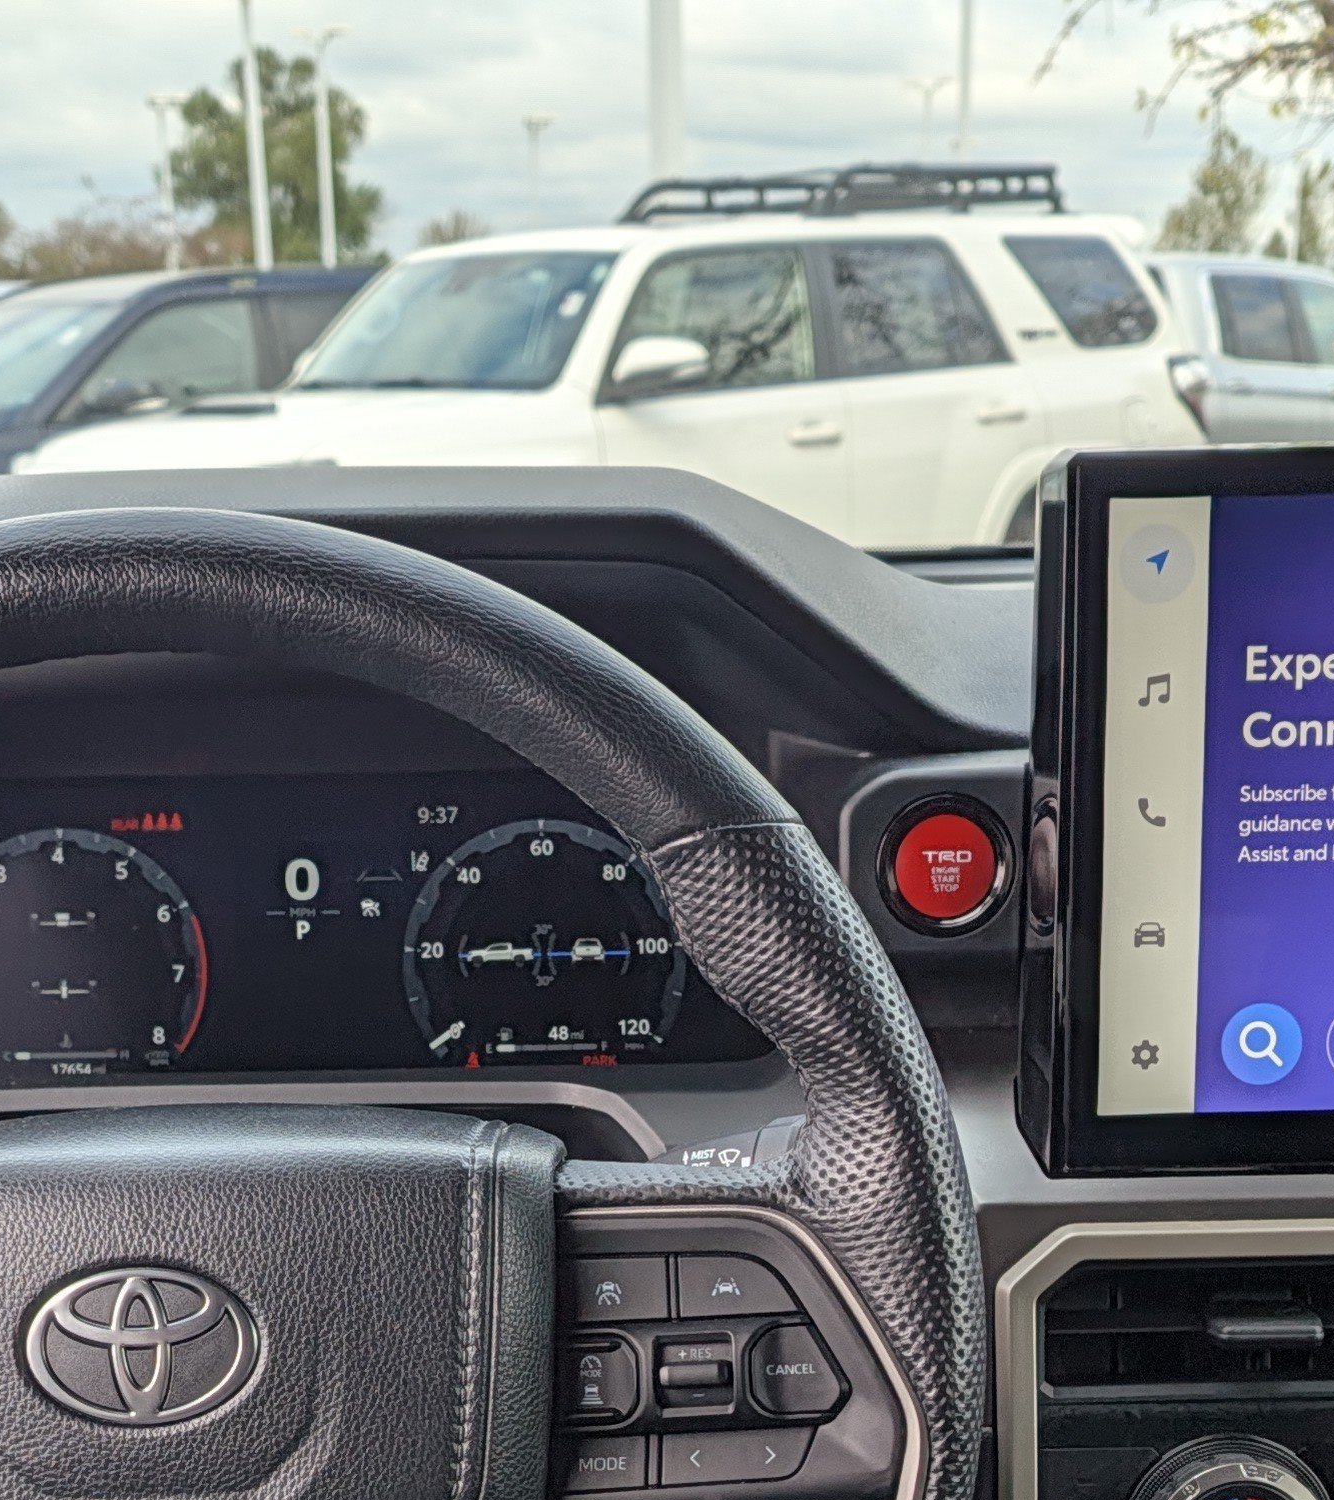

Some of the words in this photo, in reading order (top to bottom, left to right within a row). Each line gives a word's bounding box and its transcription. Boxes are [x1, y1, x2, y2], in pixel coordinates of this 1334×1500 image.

[1239, 784, 1327, 802] Subscribe
[417, 806, 459, 825] 9:37
[1238, 814, 1322, 837] guidance
[51, 848, 64, 864] 4
[529, 838, 554, 857] 60
[922, 850, 972, 863] TRD
[1238, 844, 1290, 863] Assist
[1293, 843, 1328, 861] and
[114, 861, 129, 881] 5
[284, 857, 320, 901] 0
[456, 866, 481, 885] 40
[601, 863, 627, 882] 80
[931, 866, 961, 875] ENGINE
[931, 875, 961, 885] START
[933, 884, 960, 893] STOP
[156, 904, 171, 923] 6
[296, 920, 311, 941] P
[420, 941, 445, 959] 20
[635, 937, 668, 955] 100
[172, 963, 186, 984] 7
[151, 1025, 167, 1046] 8
[547, 1025, 570, 1041] 48
[618, 1018, 651, 1036] 120
[485, 1043, 493, 1055] E
[600, 1040, 609, 1052] F
[581, 1054, 617, 1067] PARK
[691, 1148, 716, 1160] MIST
[690, 1348, 712, 1359] RES
[766, 1363, 816, 1376] CANCEL
[578, 1456, 627, 1472] MODE
